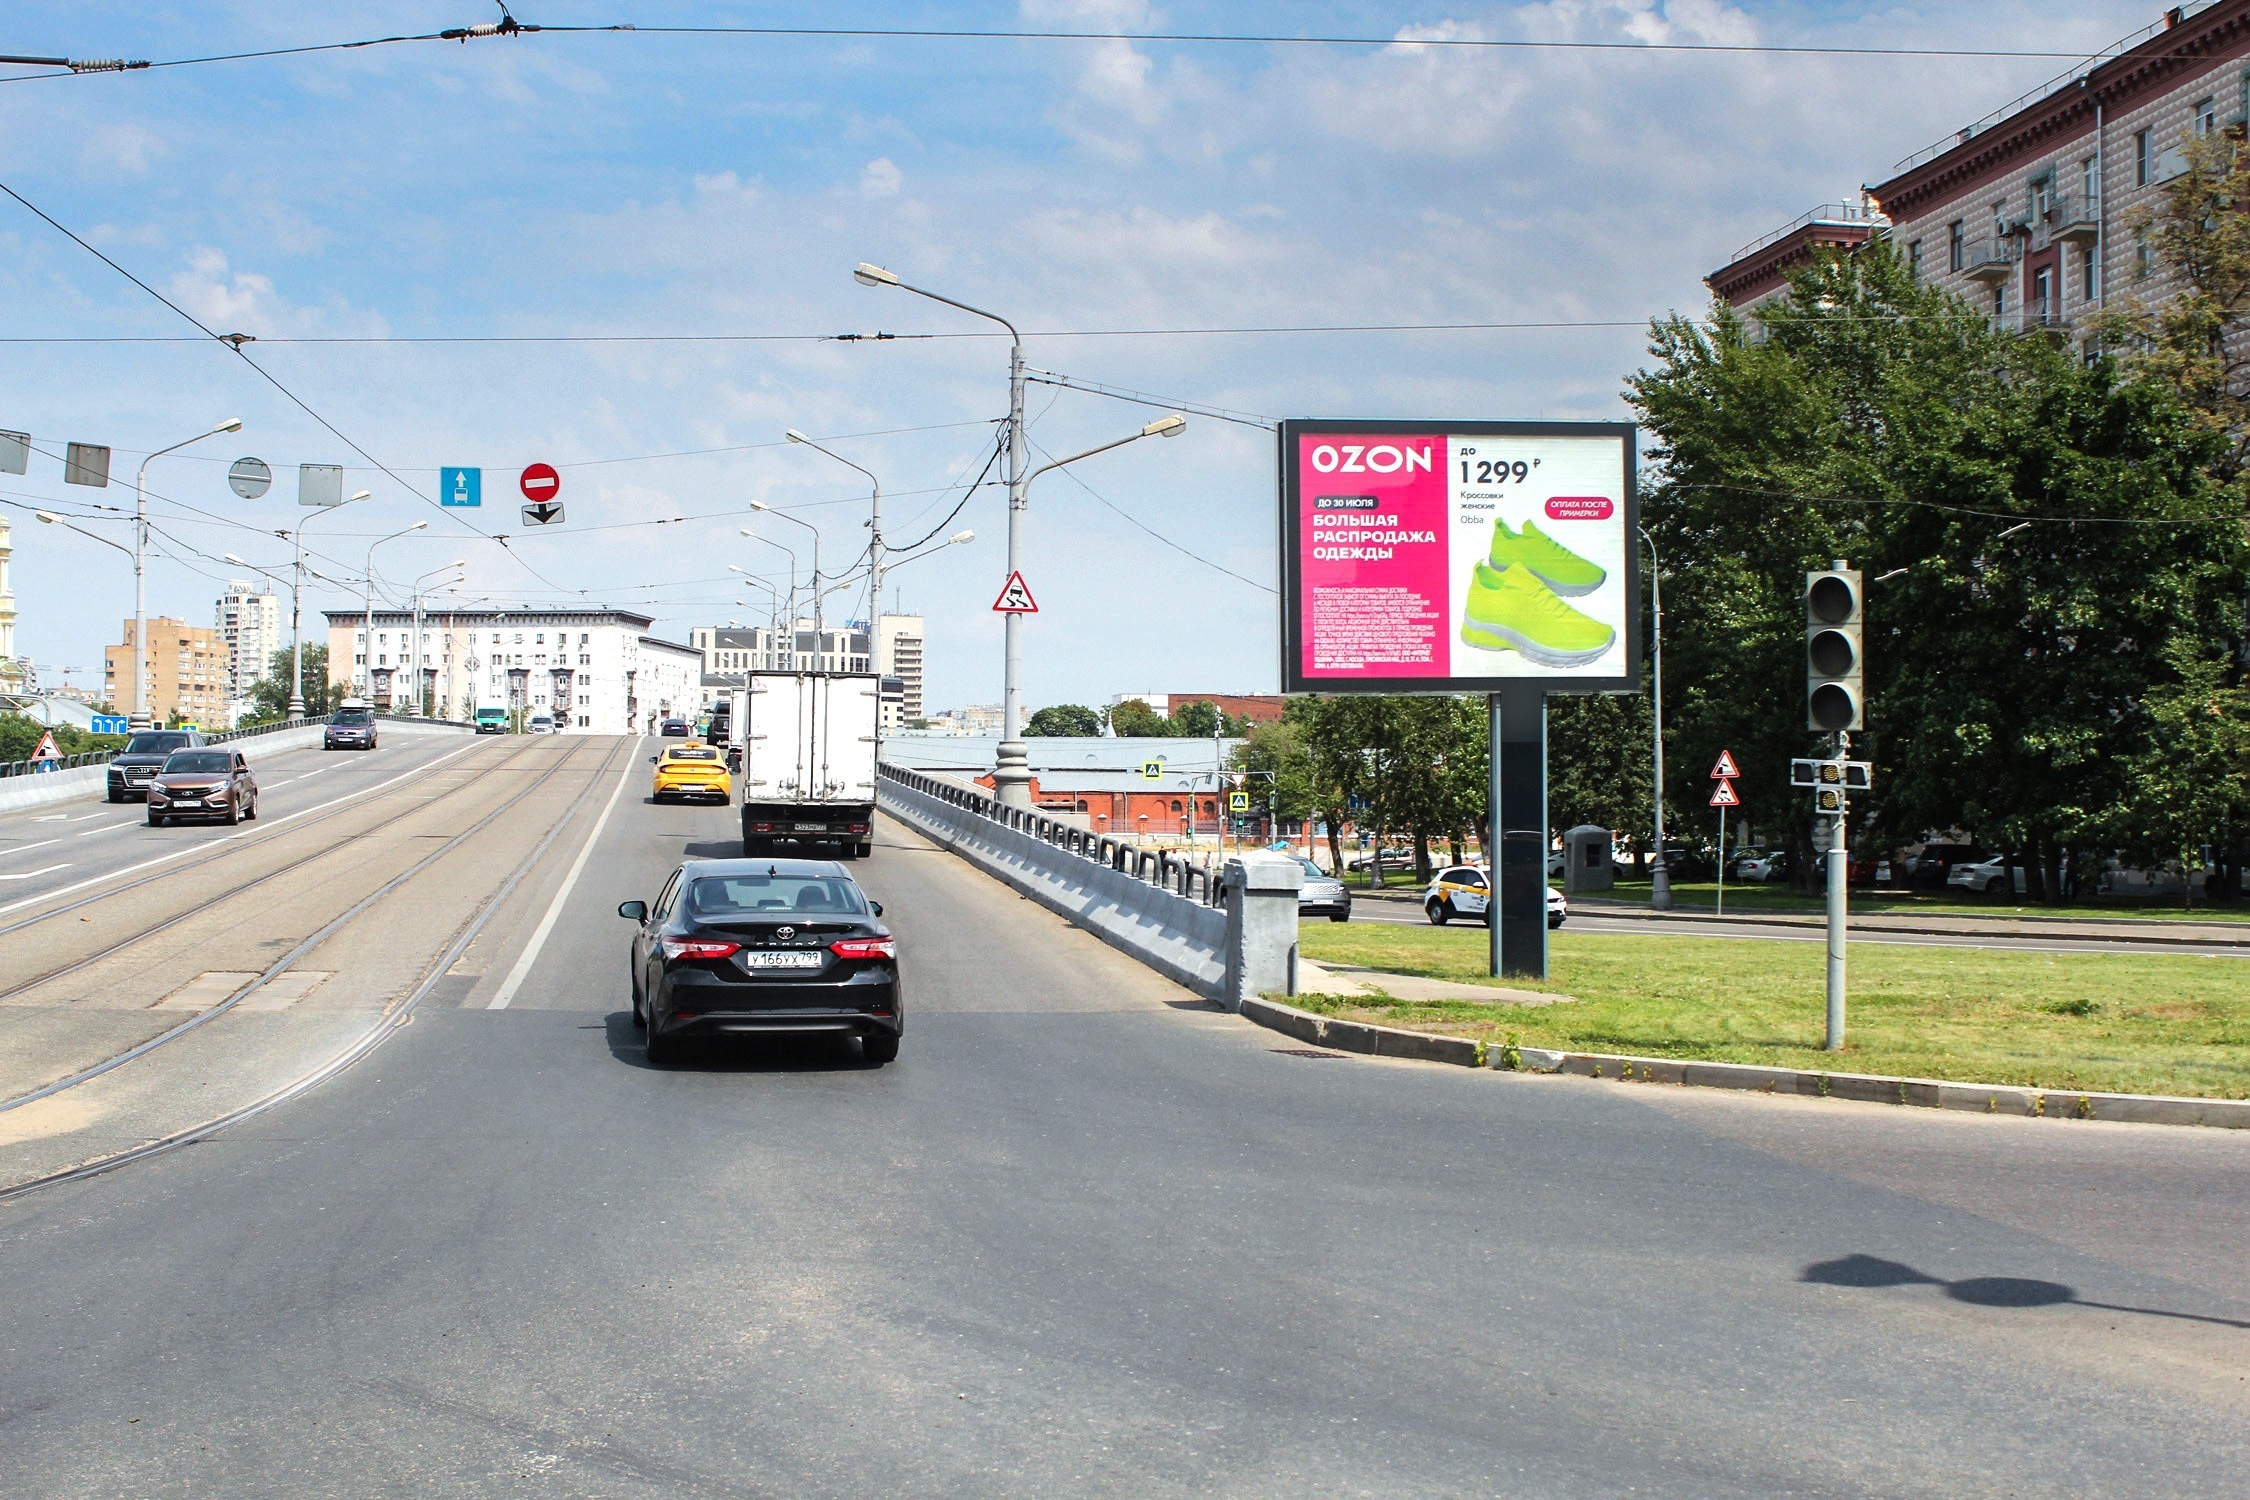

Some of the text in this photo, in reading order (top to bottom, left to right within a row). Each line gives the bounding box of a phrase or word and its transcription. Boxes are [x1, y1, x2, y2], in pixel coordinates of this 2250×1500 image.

[1460, 447, 1476, 457] до
[1312, 445, 1432, 473] OZON
[1460, 490, 1504, 501] Кроссовки
[1317, 499, 1374, 508] ДО 30 ИЮЛЯ
[1313, 514, 1398, 527] БОЛЬШАЯ
[1460, 515, 1484, 524] Obba
[1313, 531, 1436, 545] РАСПРОДАЖА
[1313, 547, 1393, 561] ОДЕЖДЫ
